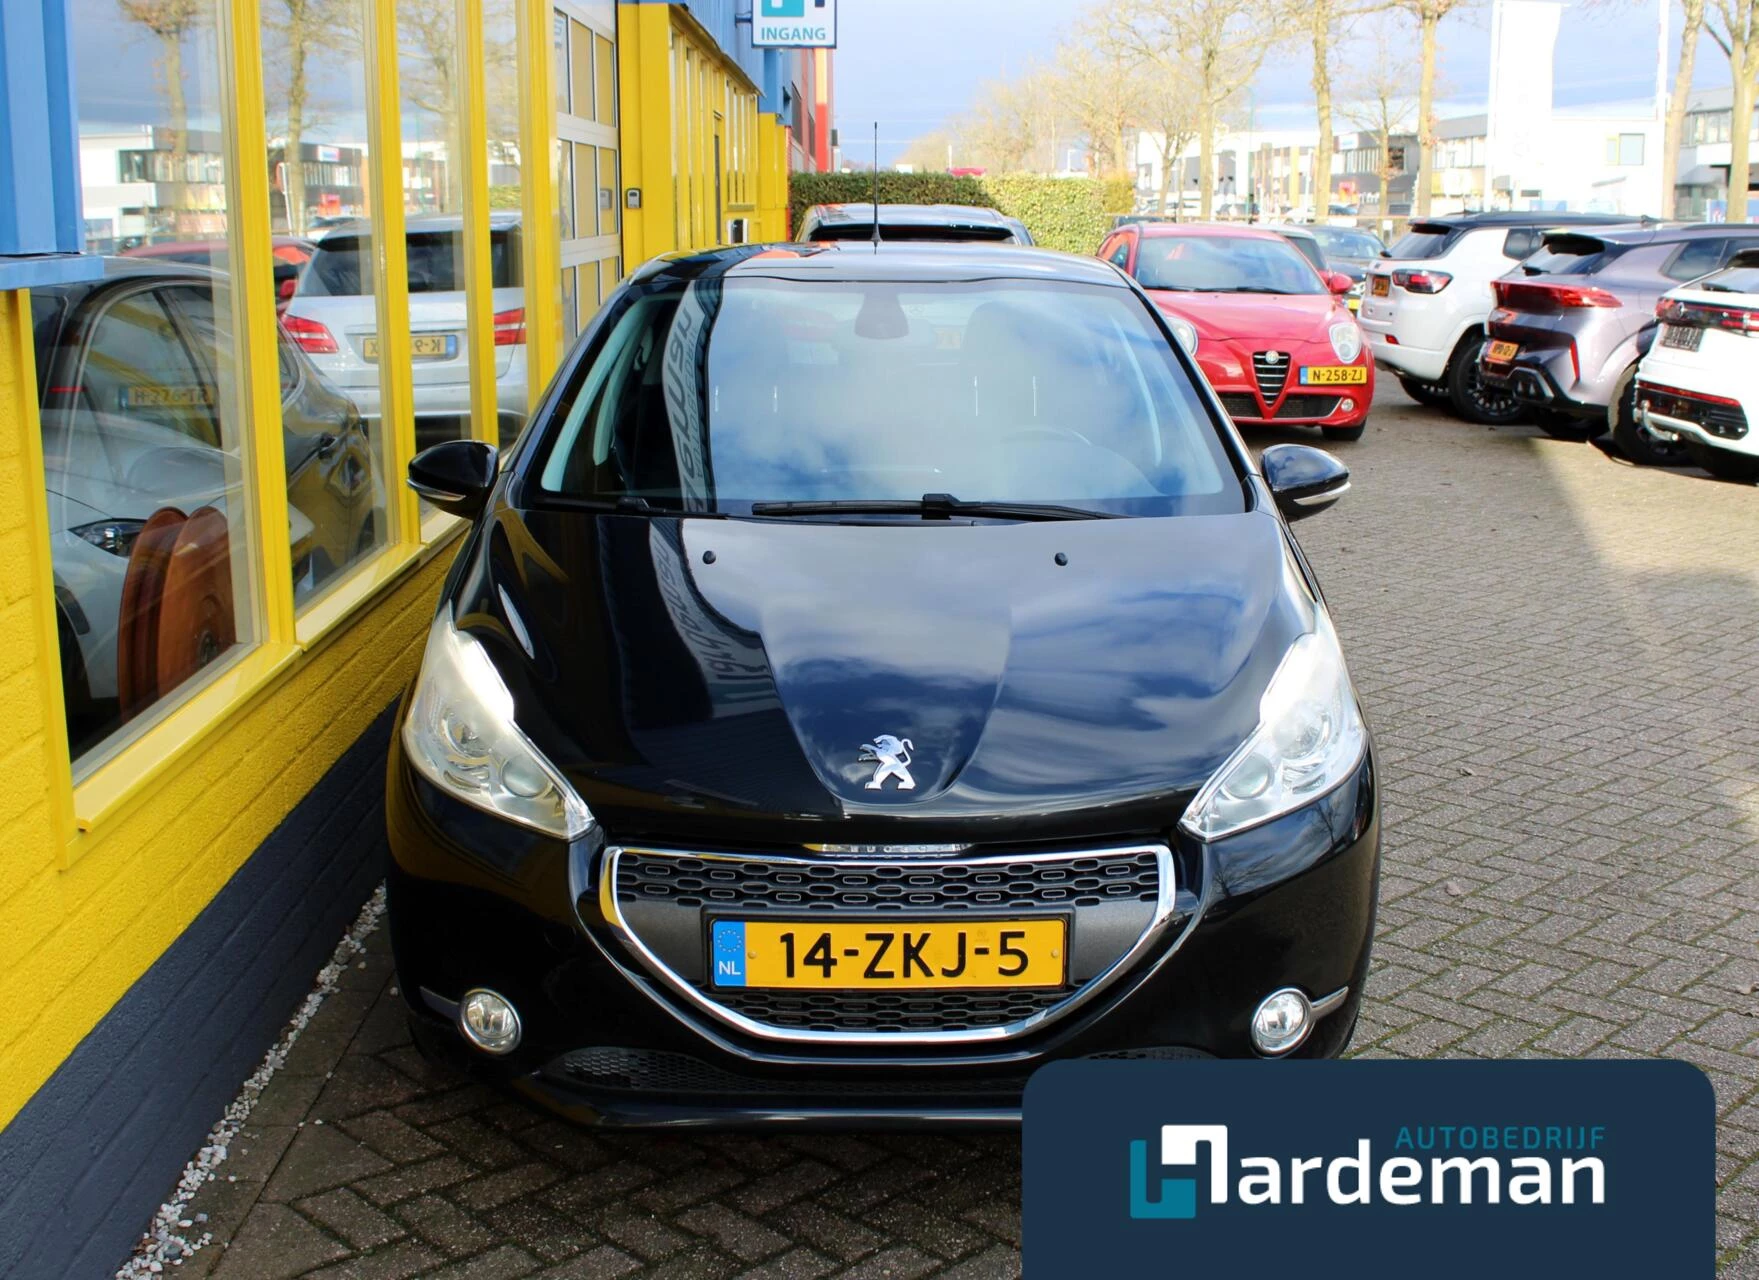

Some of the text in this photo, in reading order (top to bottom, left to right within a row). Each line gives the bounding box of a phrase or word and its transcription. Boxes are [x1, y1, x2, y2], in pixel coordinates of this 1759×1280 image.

[761, 27, 826, 40] INGANG
[1312, 369, 1363, 381] N-258-ZJ
[780, 931, 1029, 979] 14-ZKJ-5
[718, 961, 741, 975] NL
